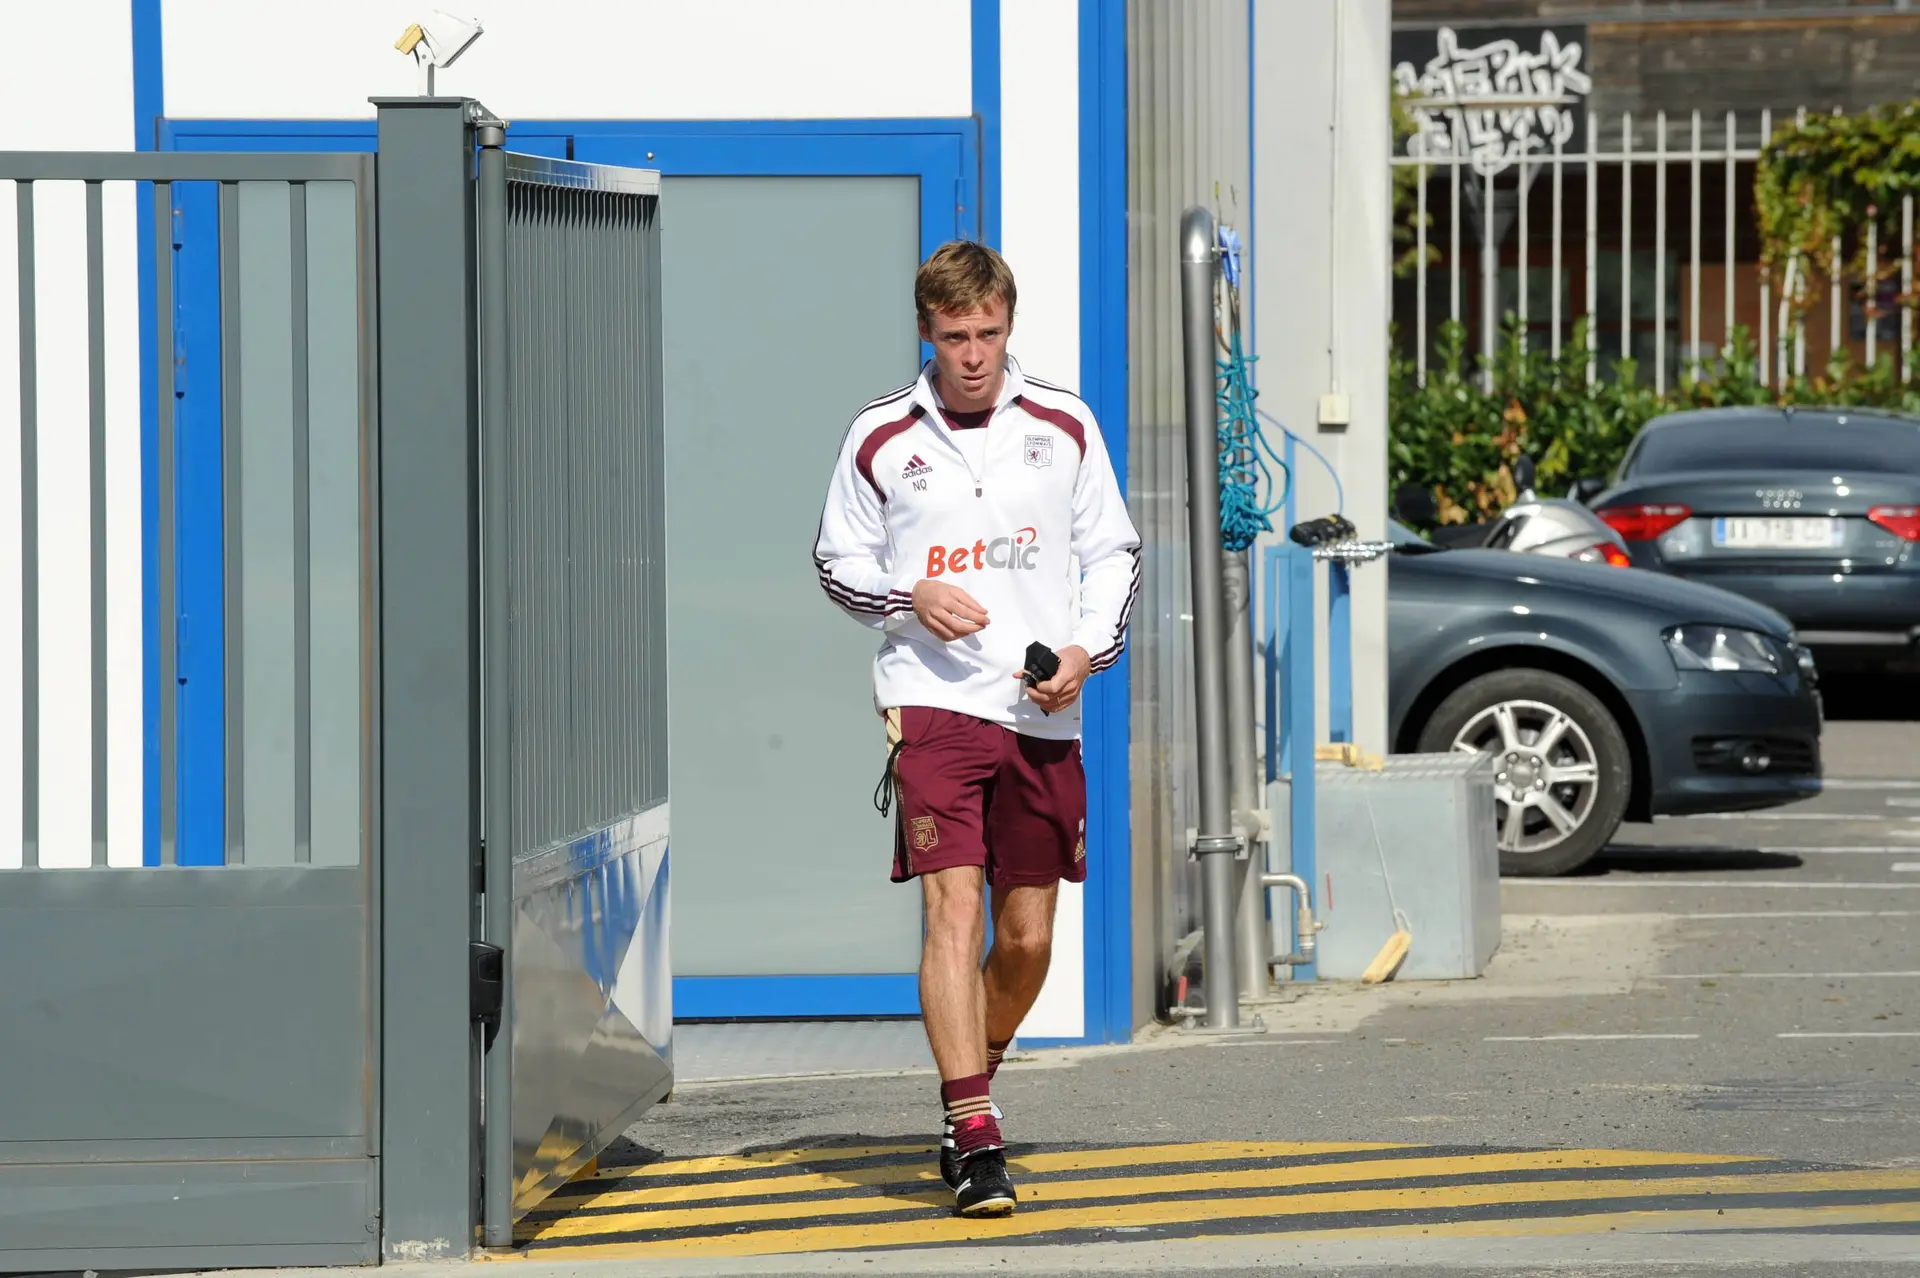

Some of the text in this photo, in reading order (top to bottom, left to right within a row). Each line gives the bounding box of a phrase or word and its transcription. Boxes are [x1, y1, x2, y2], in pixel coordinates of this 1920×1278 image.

[902, 466, 933, 479] adidas
[912, 478, 928, 492] NQ
[926, 531, 1041, 578] BetClic
